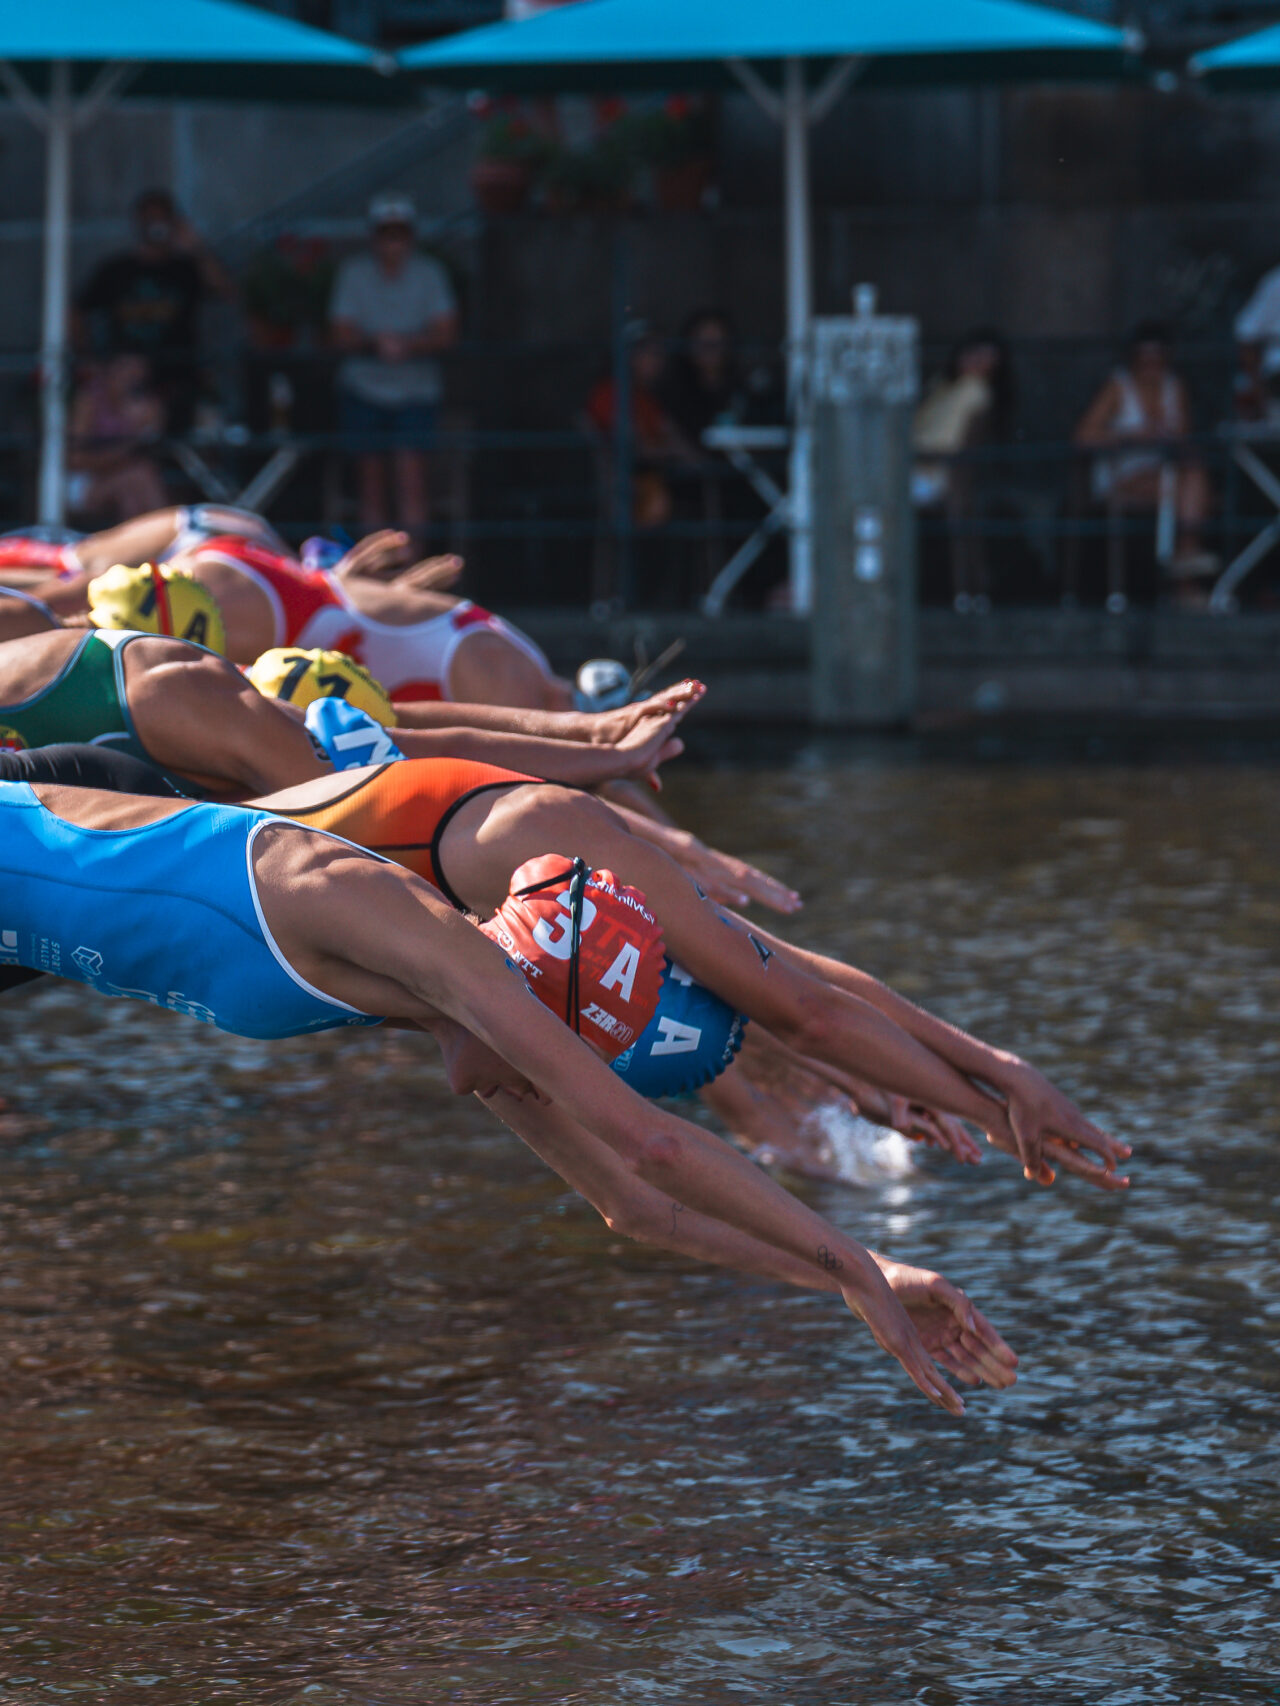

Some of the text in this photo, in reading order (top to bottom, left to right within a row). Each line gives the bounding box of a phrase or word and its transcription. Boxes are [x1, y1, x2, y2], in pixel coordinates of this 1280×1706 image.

[532, 889, 598, 960] 3
[511, 950, 544, 979] NTT
[599, 941, 641, 1003] A
[649, 1015, 702, 1056] A
